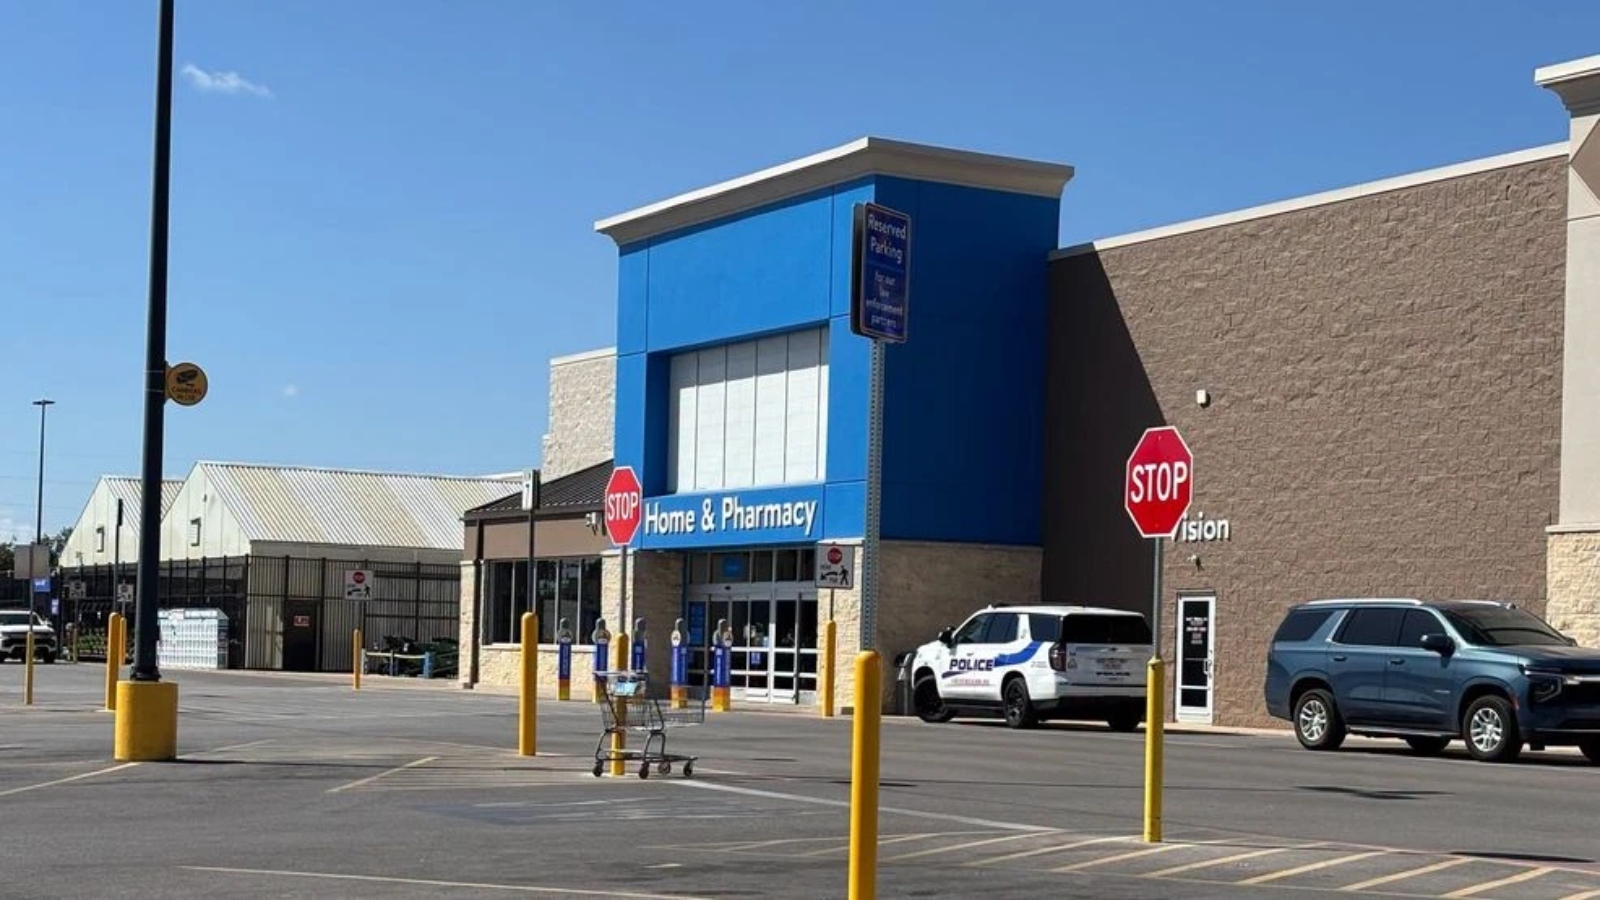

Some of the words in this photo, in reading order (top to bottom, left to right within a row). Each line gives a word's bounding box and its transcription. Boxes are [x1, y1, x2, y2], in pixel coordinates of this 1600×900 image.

[868, 214, 906, 240] Reserved
[870, 235, 902, 264] Parking
[1130, 461, 1188, 503] STOP
[608, 491, 638, 520] STOP
[645, 502, 695, 535] Home
[701, 498, 715, 532] &
[722, 497, 818, 536] Pharmacy
[1171, 512, 1229, 541] ision
[949, 658, 994, 671] POLICE
